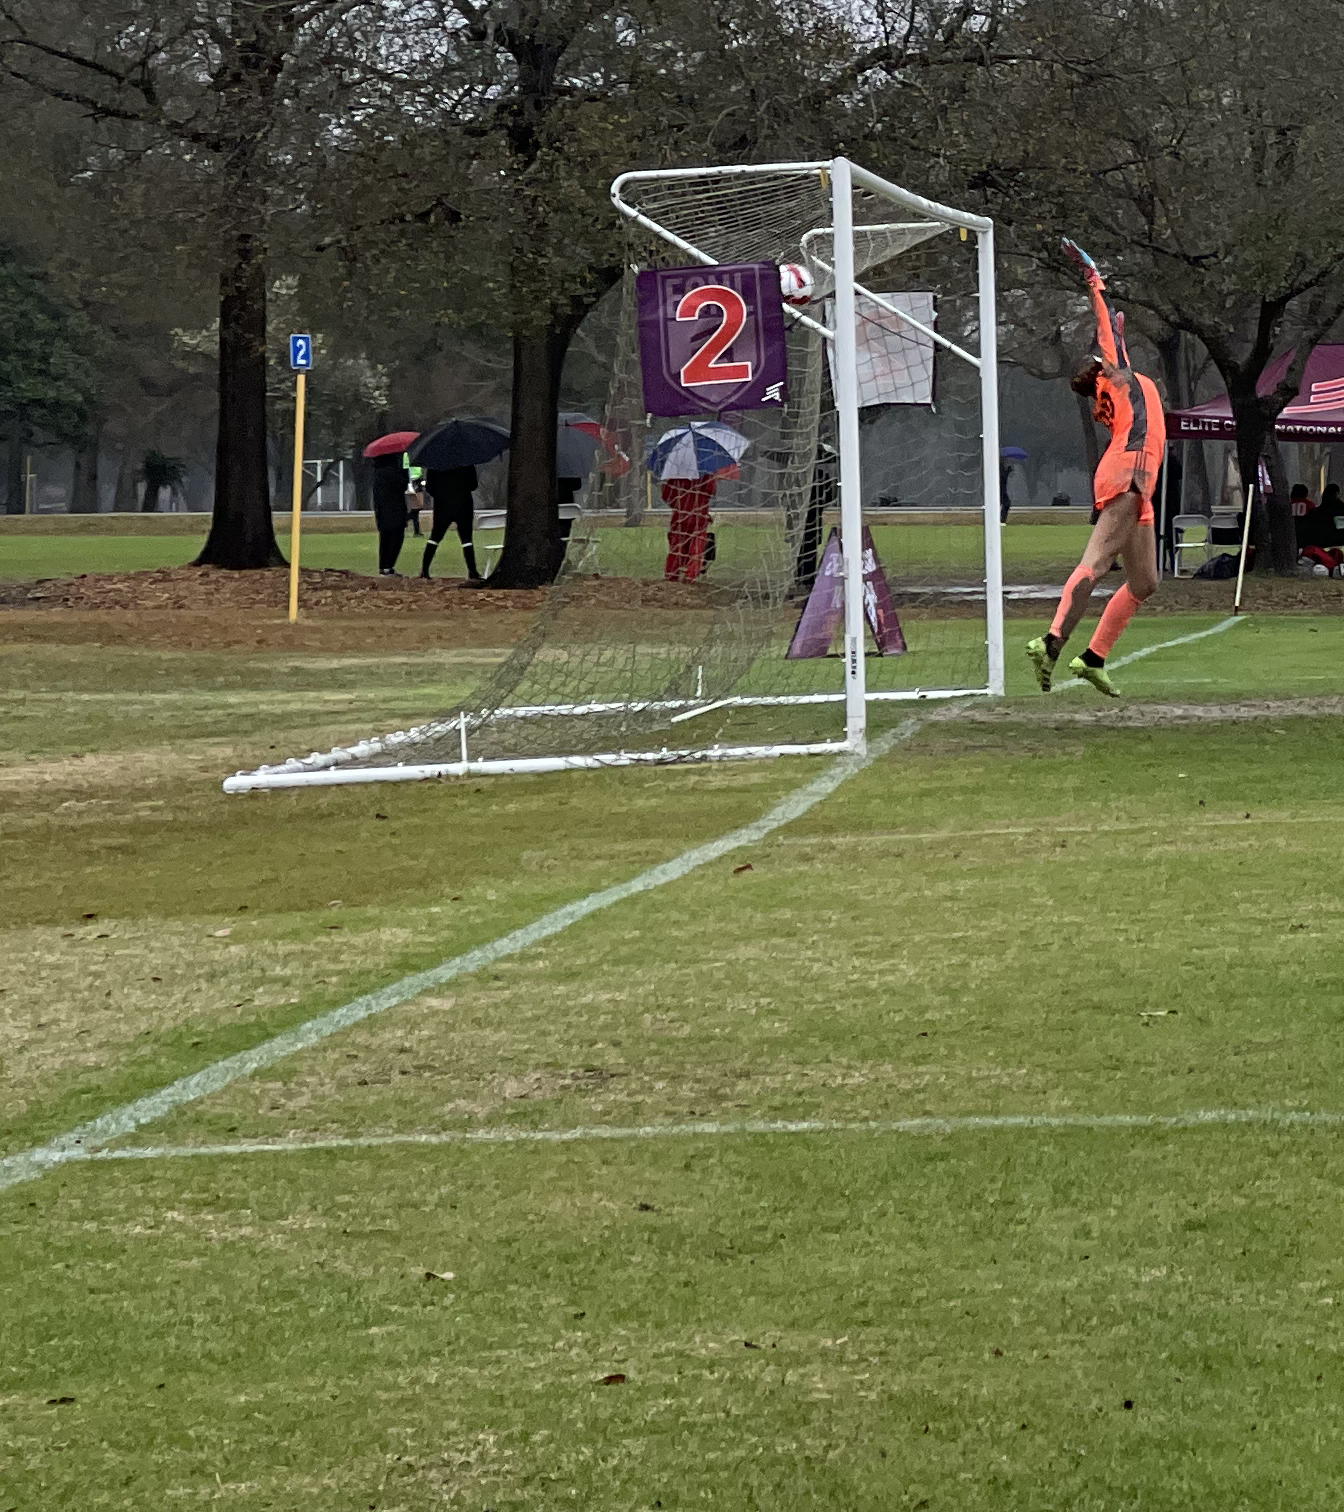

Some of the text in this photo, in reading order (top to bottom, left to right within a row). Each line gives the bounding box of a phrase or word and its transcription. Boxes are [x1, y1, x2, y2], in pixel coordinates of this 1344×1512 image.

[676, 284, 752, 387] 2
[296, 338, 307, 365] 2
[1180, 417, 1220, 431] ELITE
[1291, 497, 1307, 517] 10
